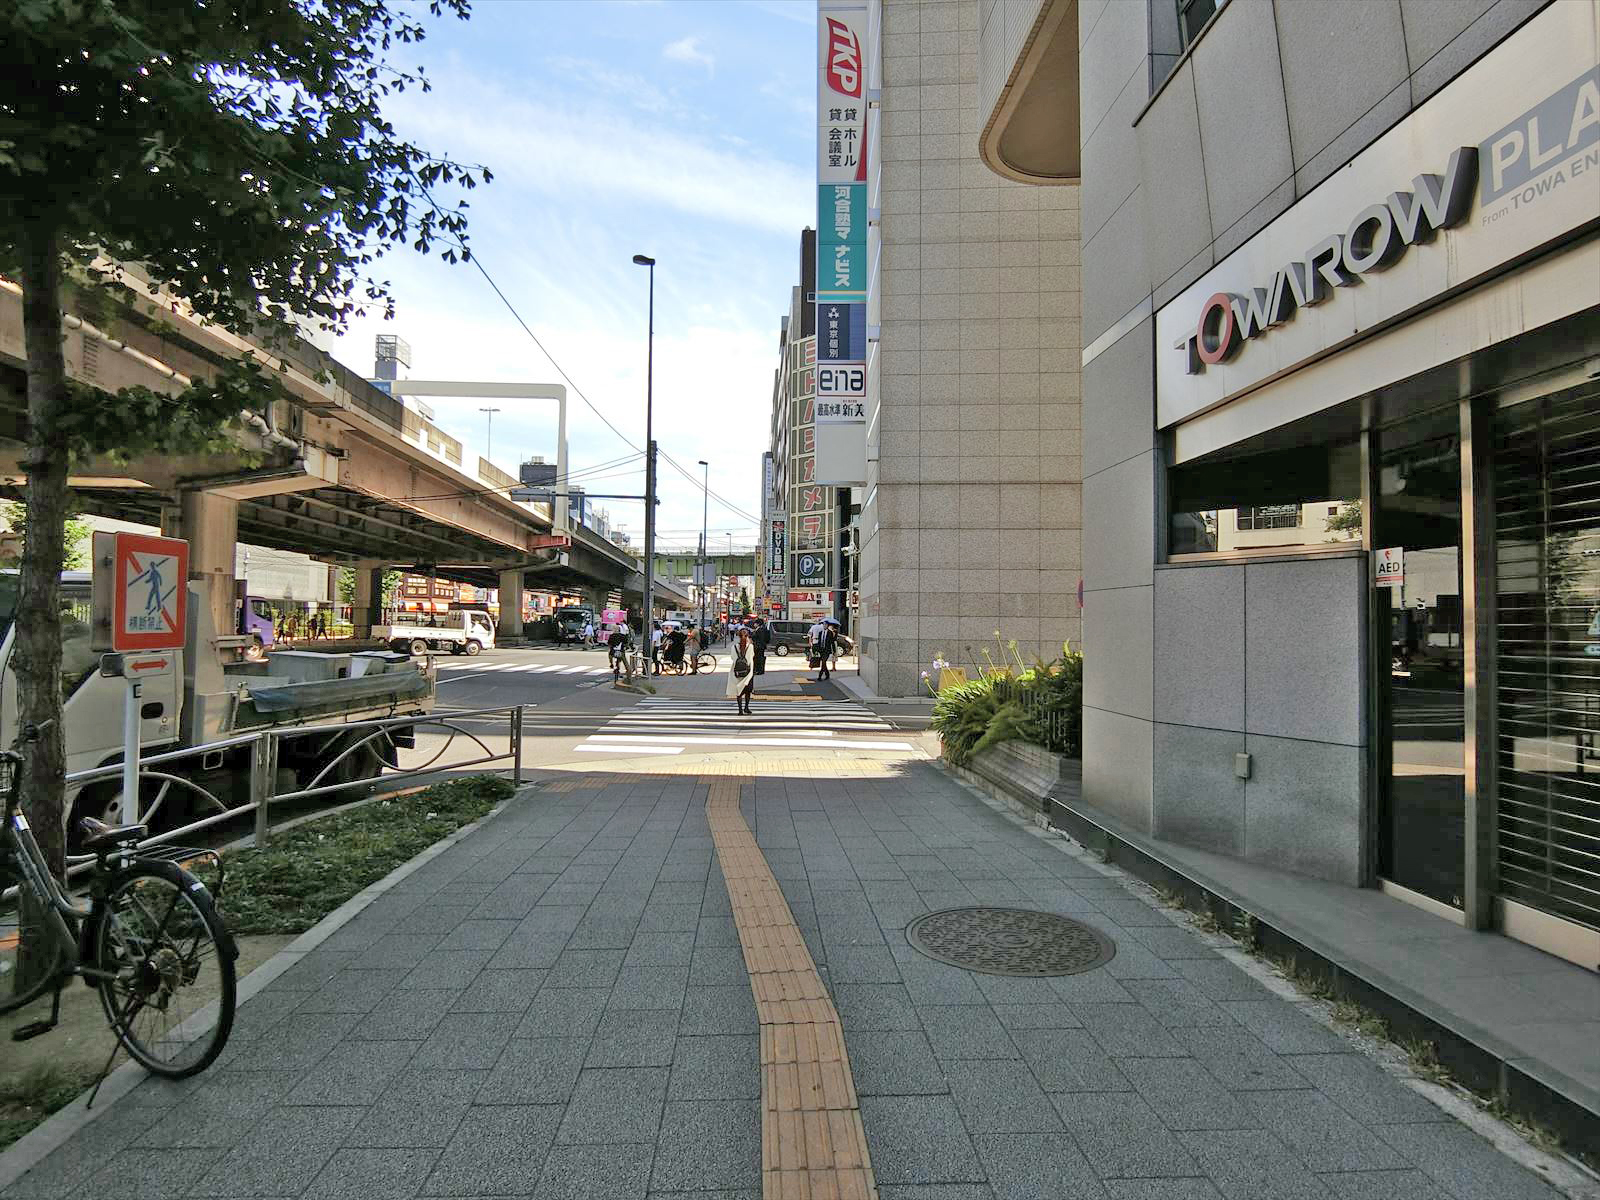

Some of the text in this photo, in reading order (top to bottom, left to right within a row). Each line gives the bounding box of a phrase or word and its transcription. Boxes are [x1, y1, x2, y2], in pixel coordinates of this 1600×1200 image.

[832, 25, 858, 93] TKP
[828, 108, 842, 167] 貸会議室
[844, 108, 858, 167] 貸ホール
[1482, 206, 1509, 227] From
[1510, 170, 1566, 209] TOWA
[834, 185, 851, 288] 河合塾マナビス
[828, 320, 839, 358] 東京個別
[1378, 561, 1400, 574] AED
[128, 616, 163, 630] 横断禁止
